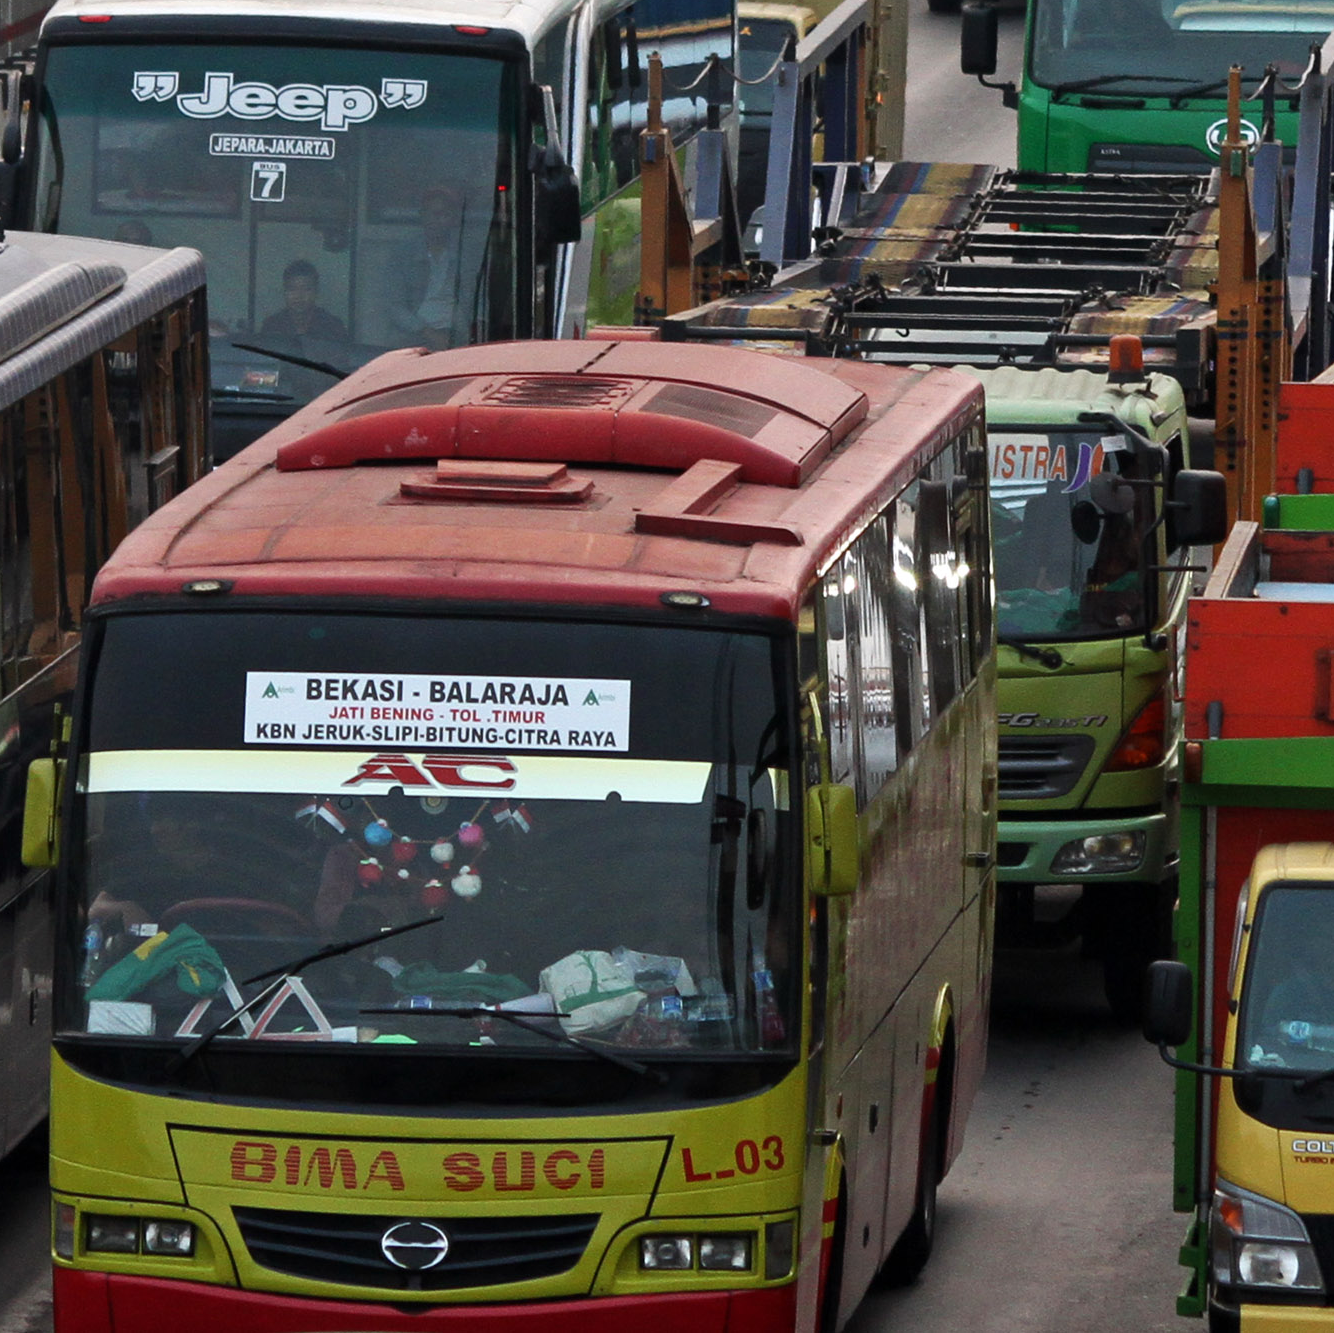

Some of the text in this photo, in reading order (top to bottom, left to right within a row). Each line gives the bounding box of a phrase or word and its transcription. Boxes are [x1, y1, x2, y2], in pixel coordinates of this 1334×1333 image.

[214, 137, 331, 156] JEPARA-JAKARTA
[258, 171, 280, 198] 7
[306, 678, 404, 702] BEKASI
[429, 680, 569, 707] BALARAJA
[328, 706, 366, 720] JATI
[370, 707, 434, 722] BENING
[450, 709, 481, 723] TOL
[256, 722, 617, 748] KBN JERUK-SLIPI-BITUNG-CITRA RAYA
[340, 753, 519, 793] AC
[230, 1141, 606, 1192] BIMA SUCI
[1294, 1155, 1329, 1165] TURBO
